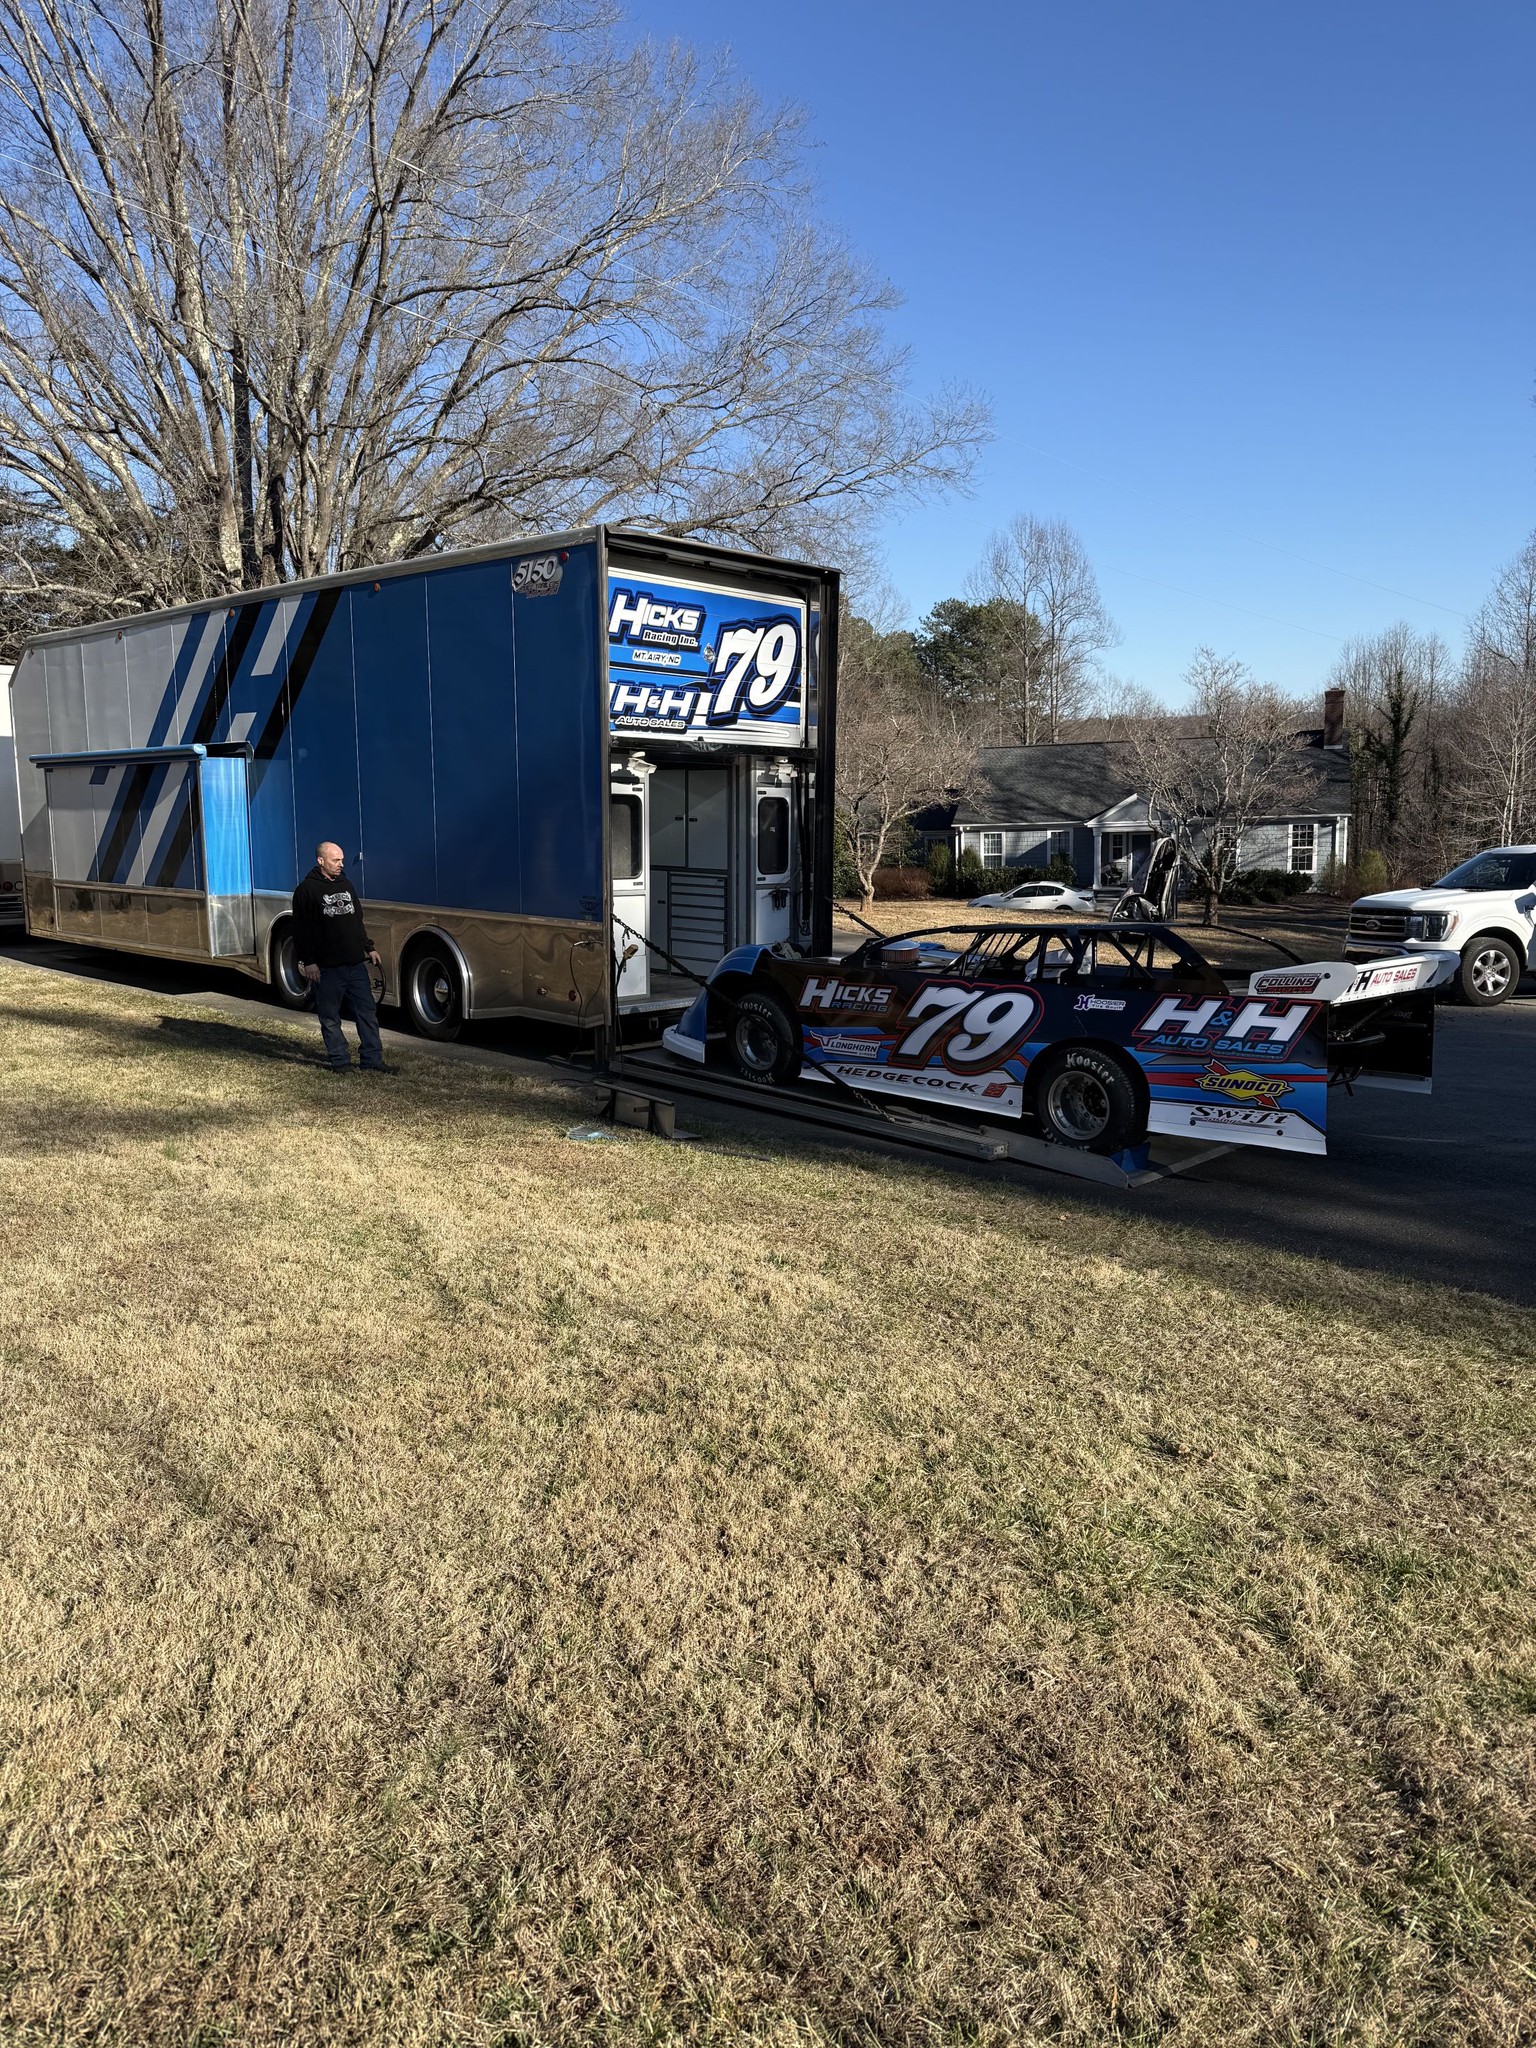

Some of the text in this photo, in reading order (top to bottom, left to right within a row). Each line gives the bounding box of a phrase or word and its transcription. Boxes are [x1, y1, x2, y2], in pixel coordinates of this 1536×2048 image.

[514, 556, 557, 585] 5150
[644, 631, 698, 646] Racing Inc.
[668, 656, 680, 664] NC
[714, 623, 797, 714] 79
[613, 684, 695, 717] H&H
[617, 716, 685, 729] AUTO SALES
[1256, 977, 1316, 989] COLLINS
[1371, 971, 1393, 985] AUTO
[1393, 968, 1418, 982] SALES
[830, 1001, 889, 1012] RACING
[899, 986, 1034, 1061] 79
[1140, 998, 1311, 1042] H&H
[830, 1041, 878, 1053] LONGHORN
[1150, 1033, 1208, 1048] AUTO
[1214, 1040, 1284, 1054] SALES
[836, 1065, 980, 1093] HEDGECOCK
[1207, 1076, 1282, 1093] SUNOCO
